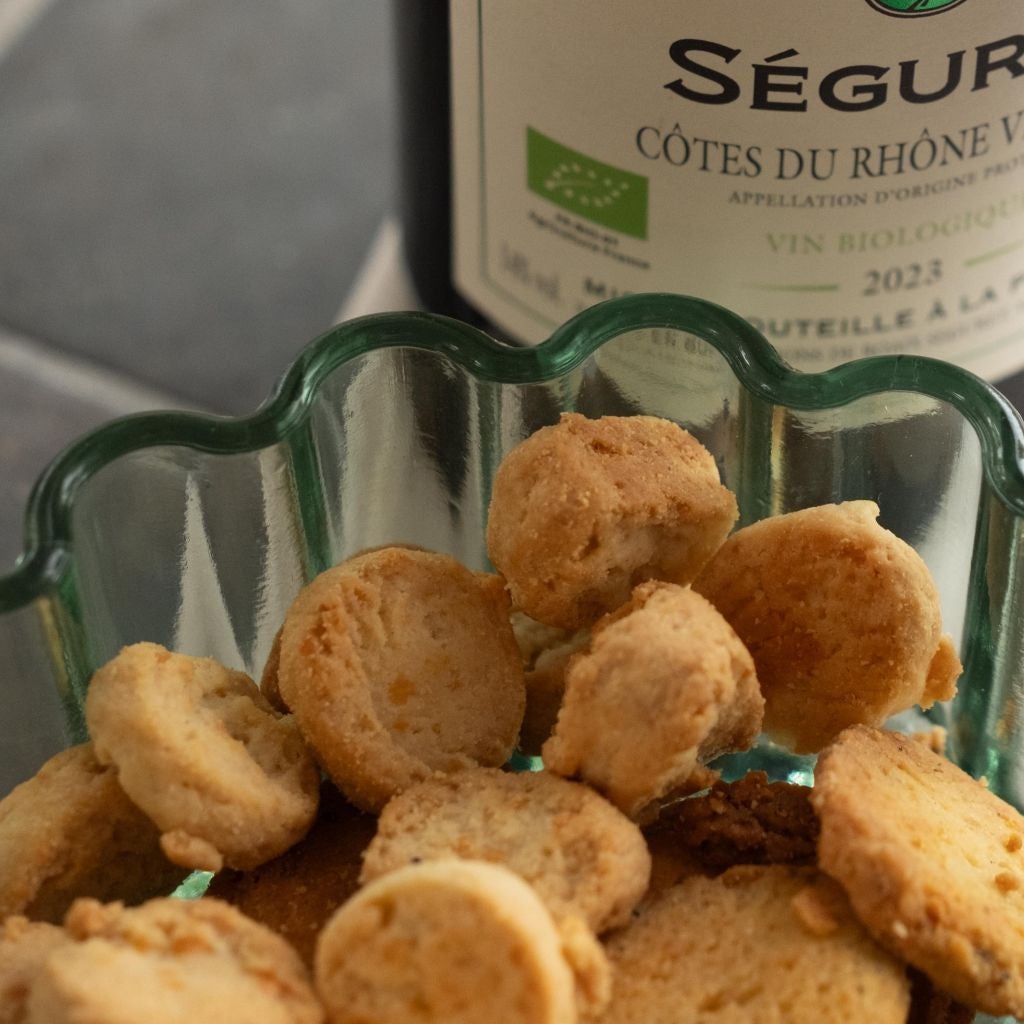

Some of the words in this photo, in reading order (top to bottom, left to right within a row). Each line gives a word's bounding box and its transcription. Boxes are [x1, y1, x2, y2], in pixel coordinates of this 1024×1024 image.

[635, 122, 763, 178] CÔTES
[776, 147, 839, 181] DU
[850, 127, 990, 179] RHÔNE
[728, 189, 868, 209] APPELLATION
[873, 169, 979, 205] D'ORIGINE
[765, 231, 824, 255] VIN
[862, 257, 943, 298] 2023
